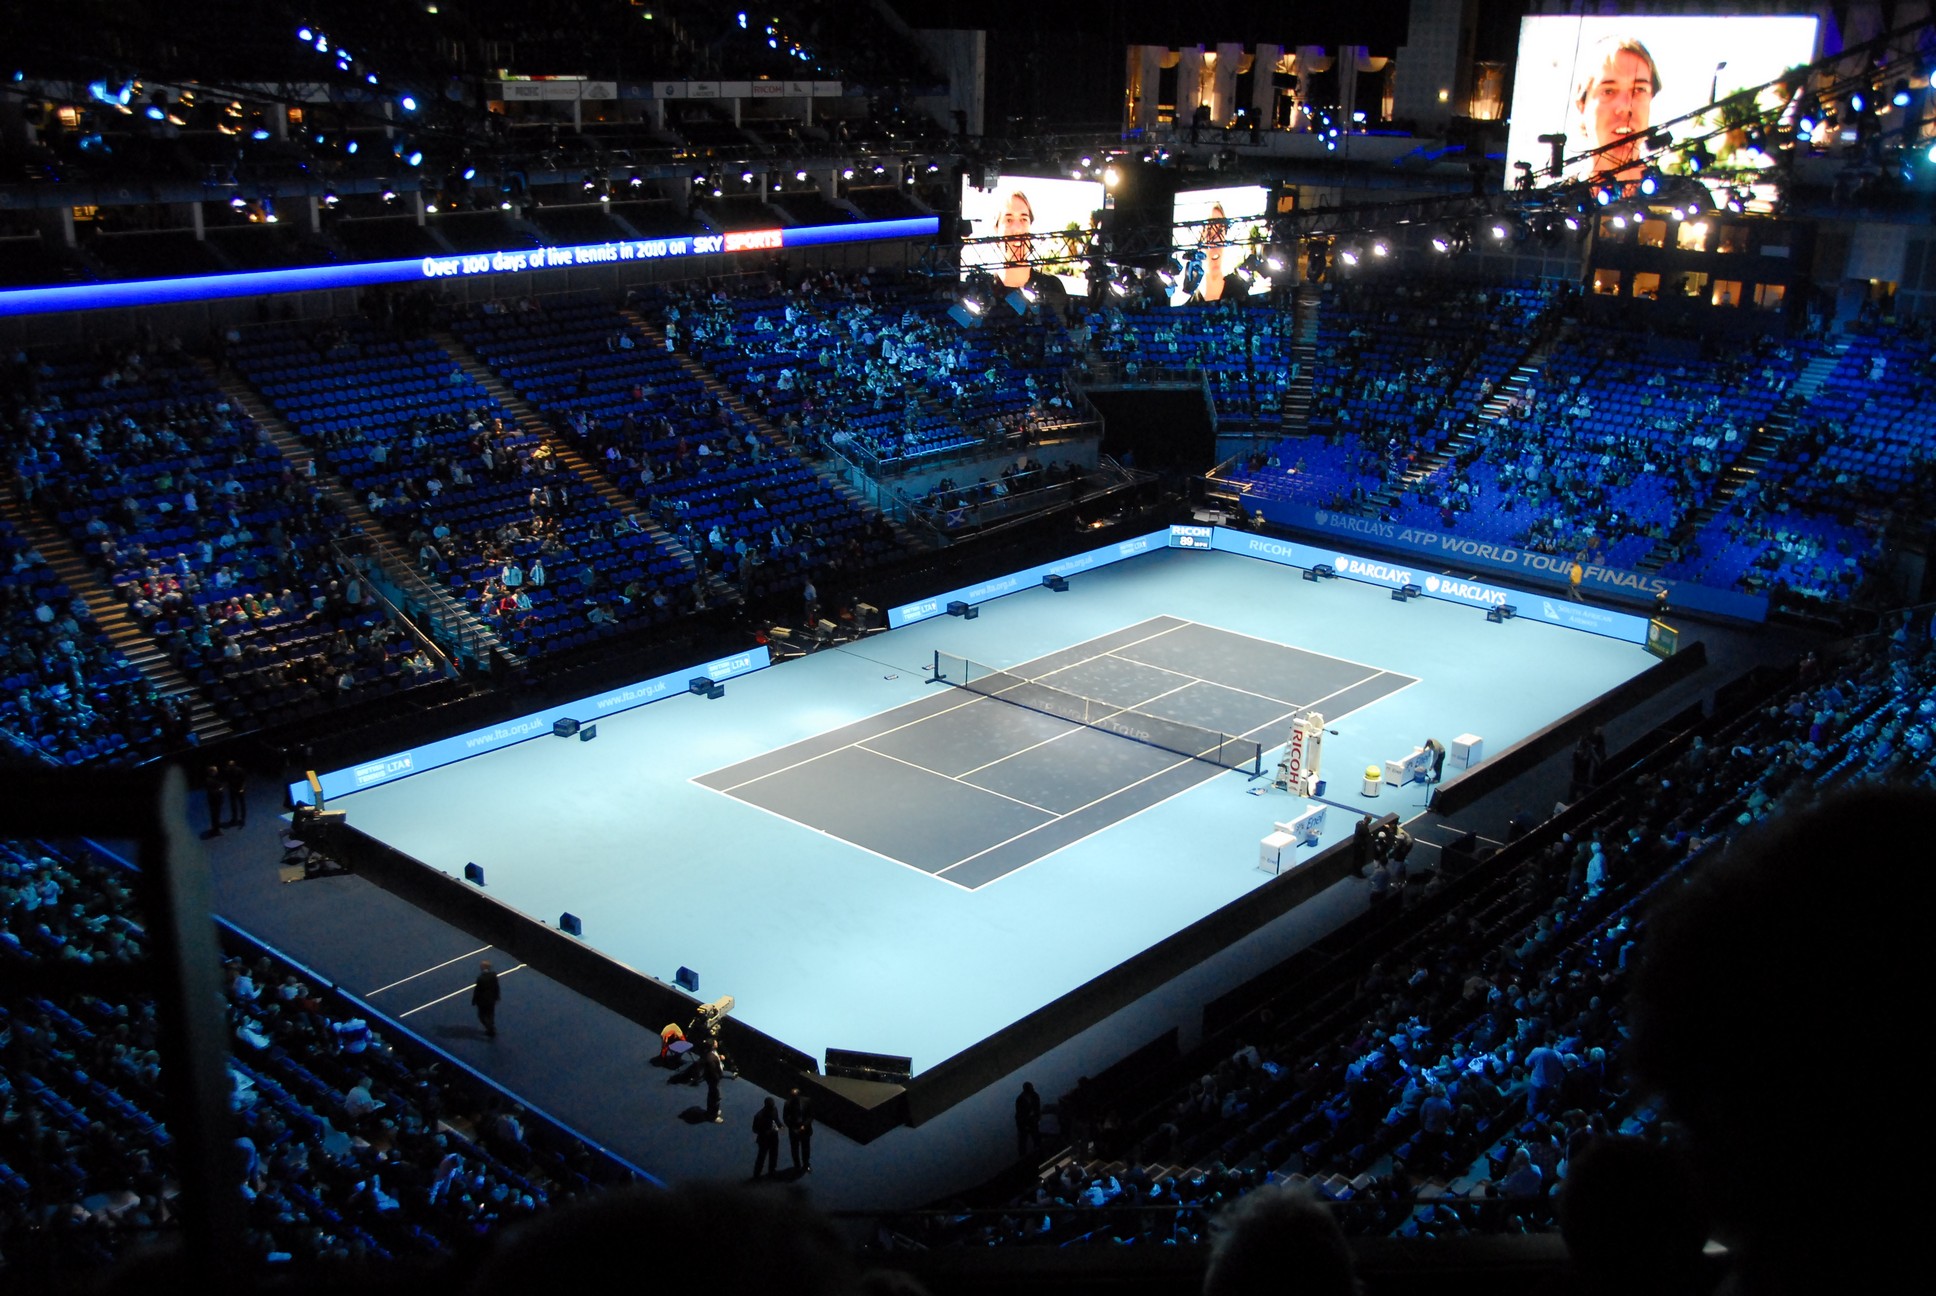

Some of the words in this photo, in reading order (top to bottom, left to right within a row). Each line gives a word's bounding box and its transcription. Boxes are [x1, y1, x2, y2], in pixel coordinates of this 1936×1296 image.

[754, 86, 782, 94] RICOH
[422, 257, 460, 277] Over
[462, 256, 489, 273] 100
[492, 251, 526, 272] days
[529, 248, 546, 267] of
[547, 247, 572, 266] live
[575, 243, 617, 263] tennis
[620, 241, 633, 259] in
[637, 241, 666, 258] 2010
[669, 241, 686, 255] on
[693, 235, 723, 254] SKY
[725, 231, 782, 250] SPORTS
[1171, 526, 1210, 537] RICOH
[1330, 514, 1394, 538] BARCLAYS
[1398, 529, 1438, 545] ATP
[1442, 536, 1518, 563] WORLD
[1179, 536, 1193, 547] 89
[1249, 540, 1292, 558] RICOH
[1349, 560, 1412, 585] BARCLAYS
[1440, 579, 1507, 605] BARCLAYS
[921, 603, 932, 613] LTA
[731, 659, 745, 669] LTA
[597, 681, 666, 709] www.lta.org.uk
[466, 717, 544, 748] www.lta.org.uk
[387, 760, 405, 772] LTA
[1289, 729, 1303, 784] RICOH
[1306, 811, 1325, 830] Enel
